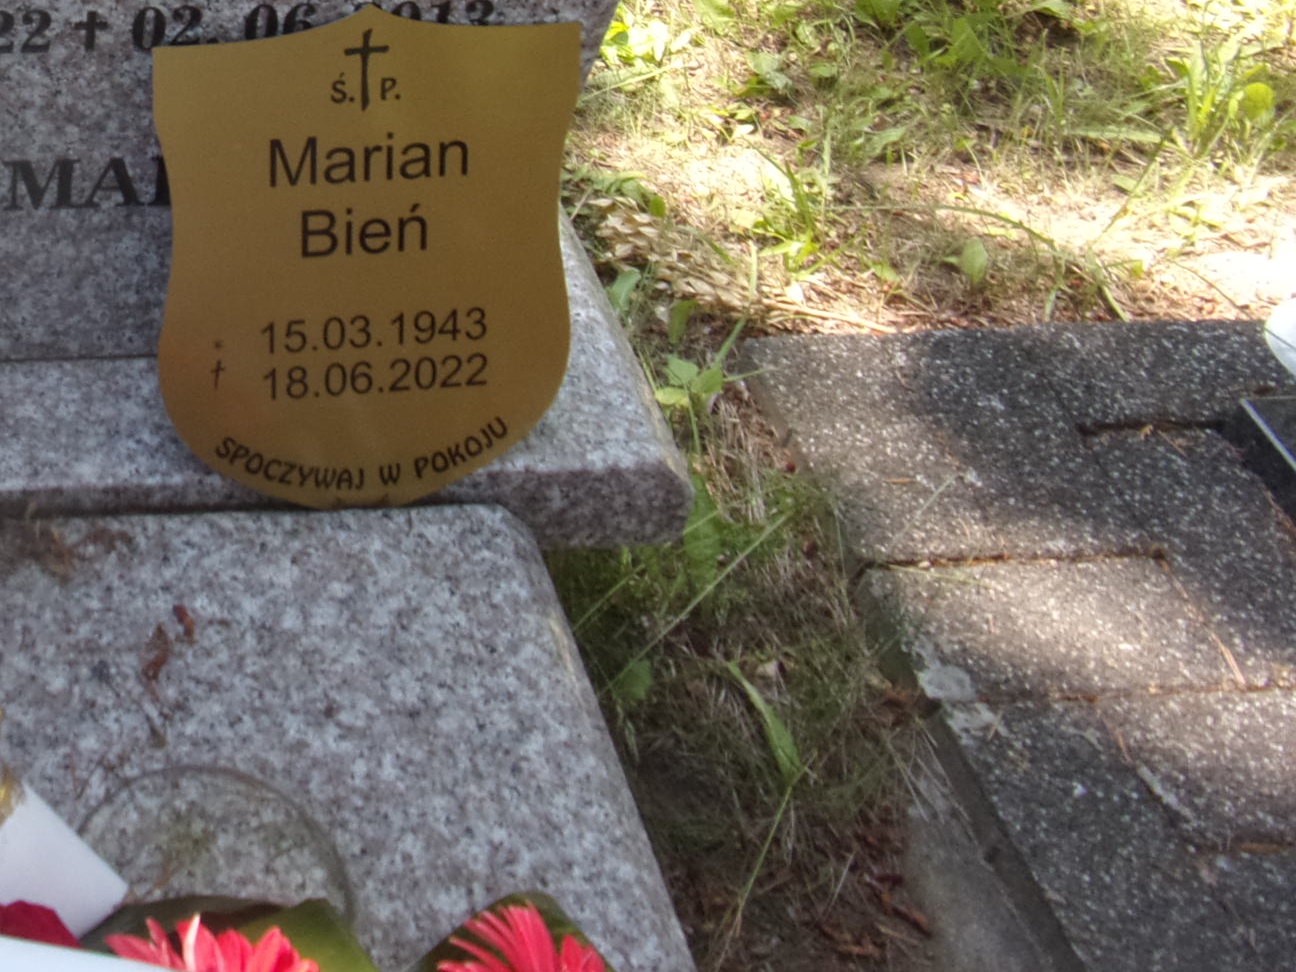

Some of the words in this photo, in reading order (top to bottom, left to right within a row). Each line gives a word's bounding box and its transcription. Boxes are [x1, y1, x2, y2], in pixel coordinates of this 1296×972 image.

[267, 132, 470, 188] Marian
[300, 203, 429, 259] Bień
[262, 306, 488, 355] 15.03.1943
[262, 353, 489, 401] 18.06.2022
[215, 436, 366, 490] SPOCZYWAJ
[379, 463, 401, 486] W
[415, 416, 510, 480] POKOJU
